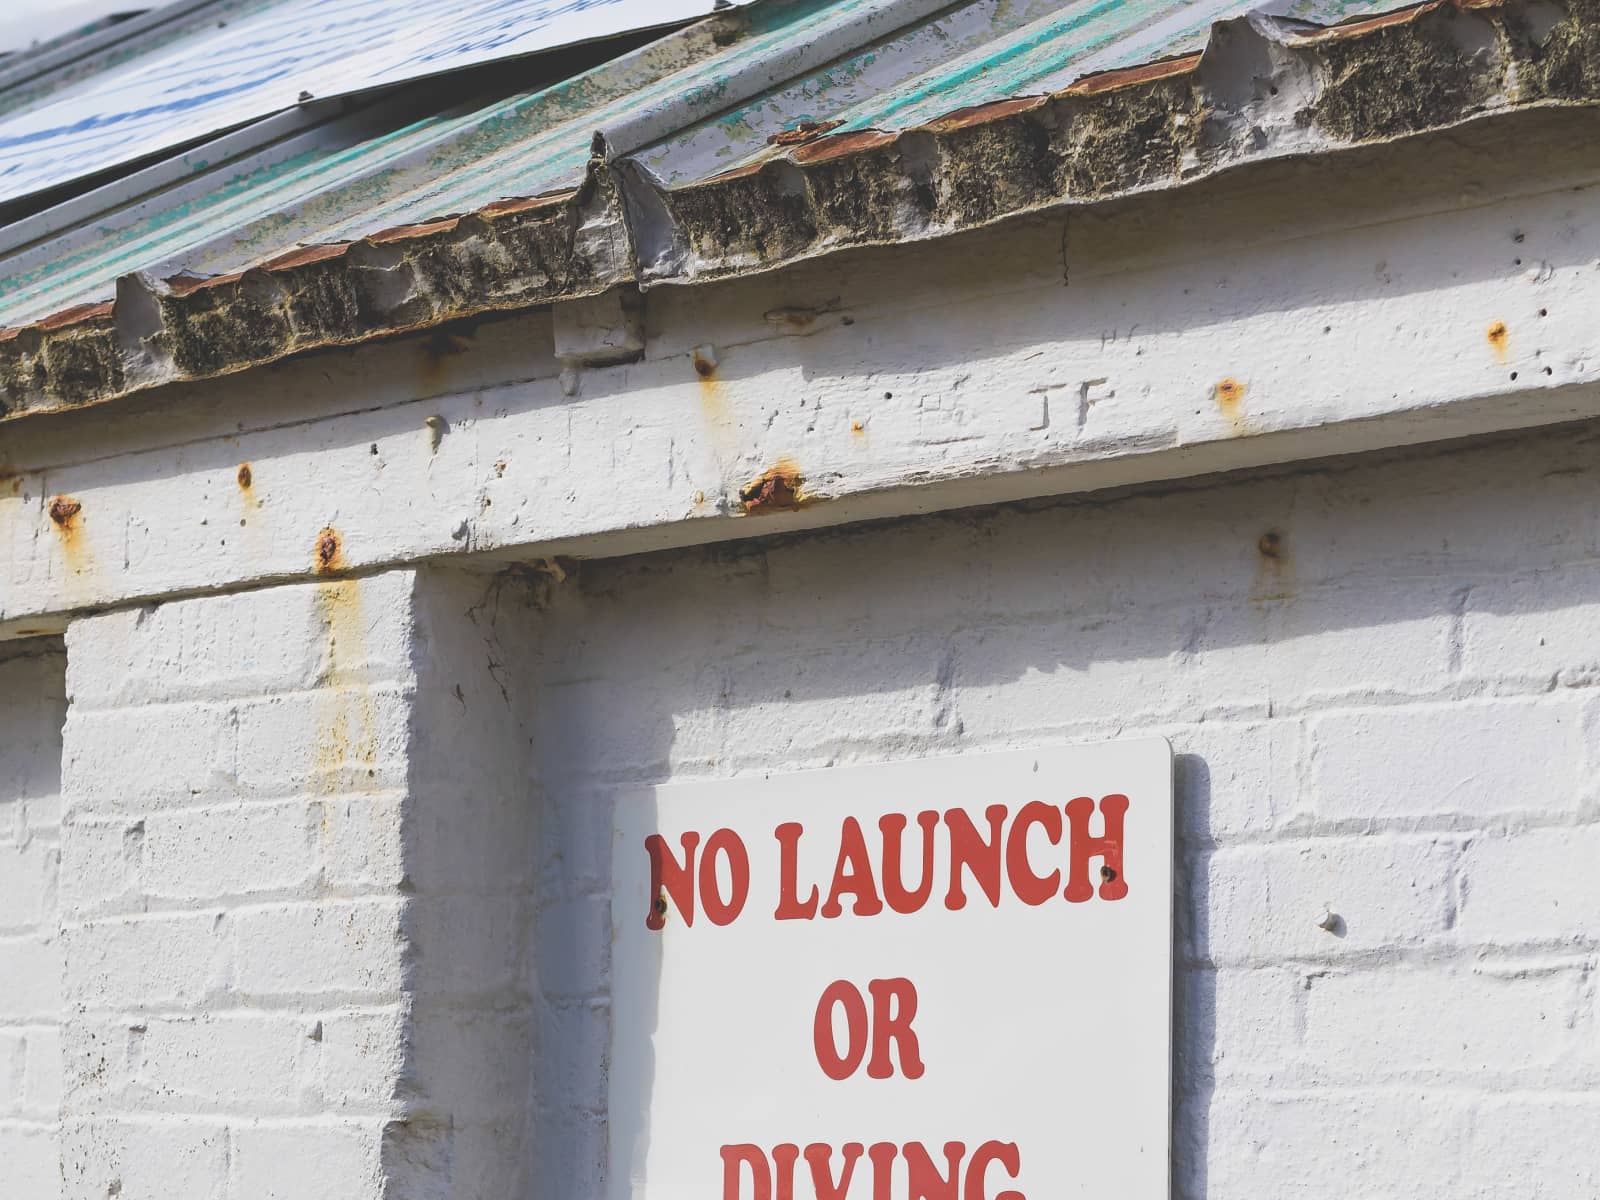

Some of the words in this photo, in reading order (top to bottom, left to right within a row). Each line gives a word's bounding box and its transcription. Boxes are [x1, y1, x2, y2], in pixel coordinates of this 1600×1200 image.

[645, 828, 750, 929] NO
[774, 793, 1130, 921] LAUNCH
[813, 977, 925, 1081] OR
